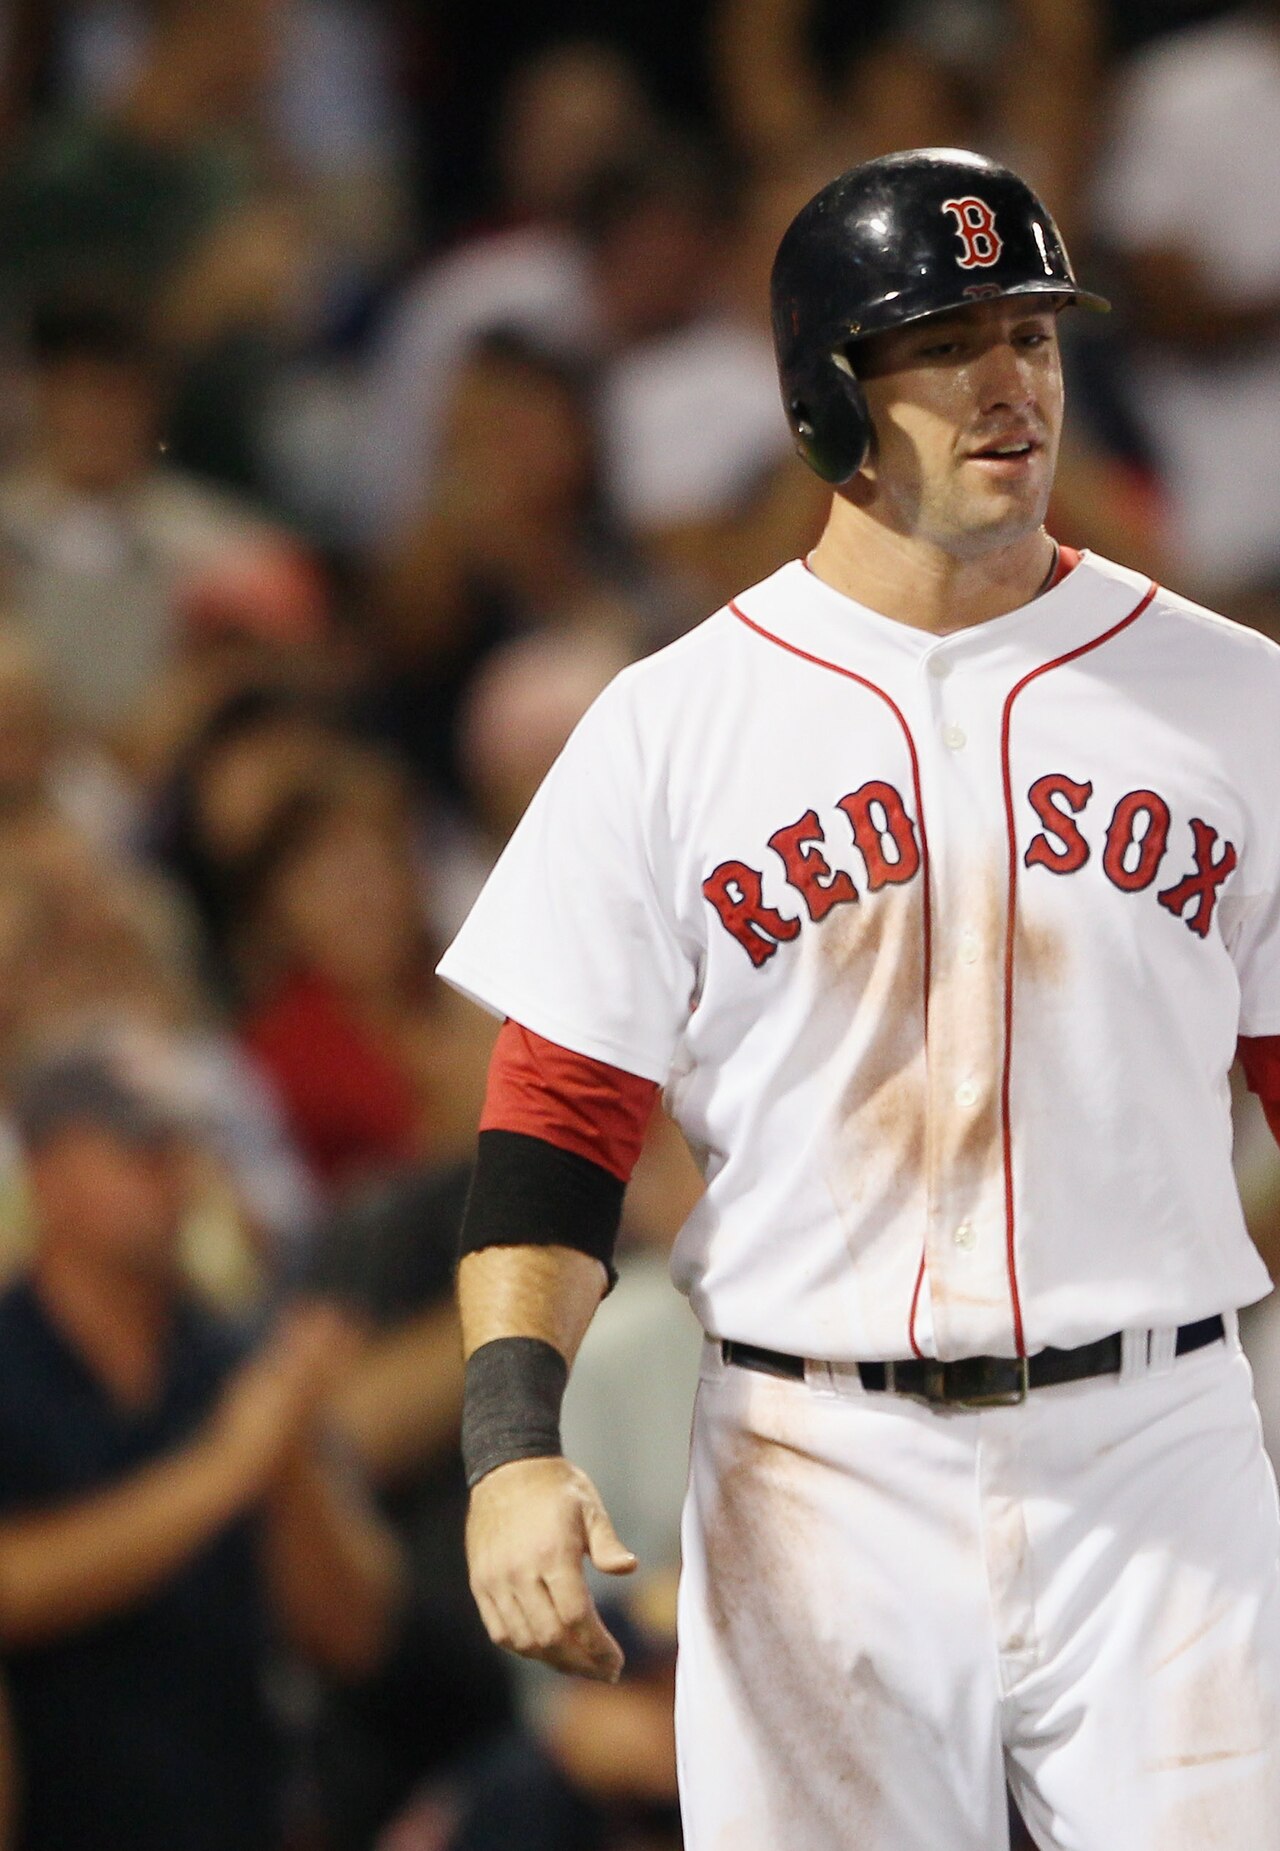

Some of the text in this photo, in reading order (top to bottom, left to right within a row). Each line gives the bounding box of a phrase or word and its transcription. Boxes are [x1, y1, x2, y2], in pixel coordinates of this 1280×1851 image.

[941, 196, 1003, 269] B
[702, 773, 1237, 968] RED SOX
